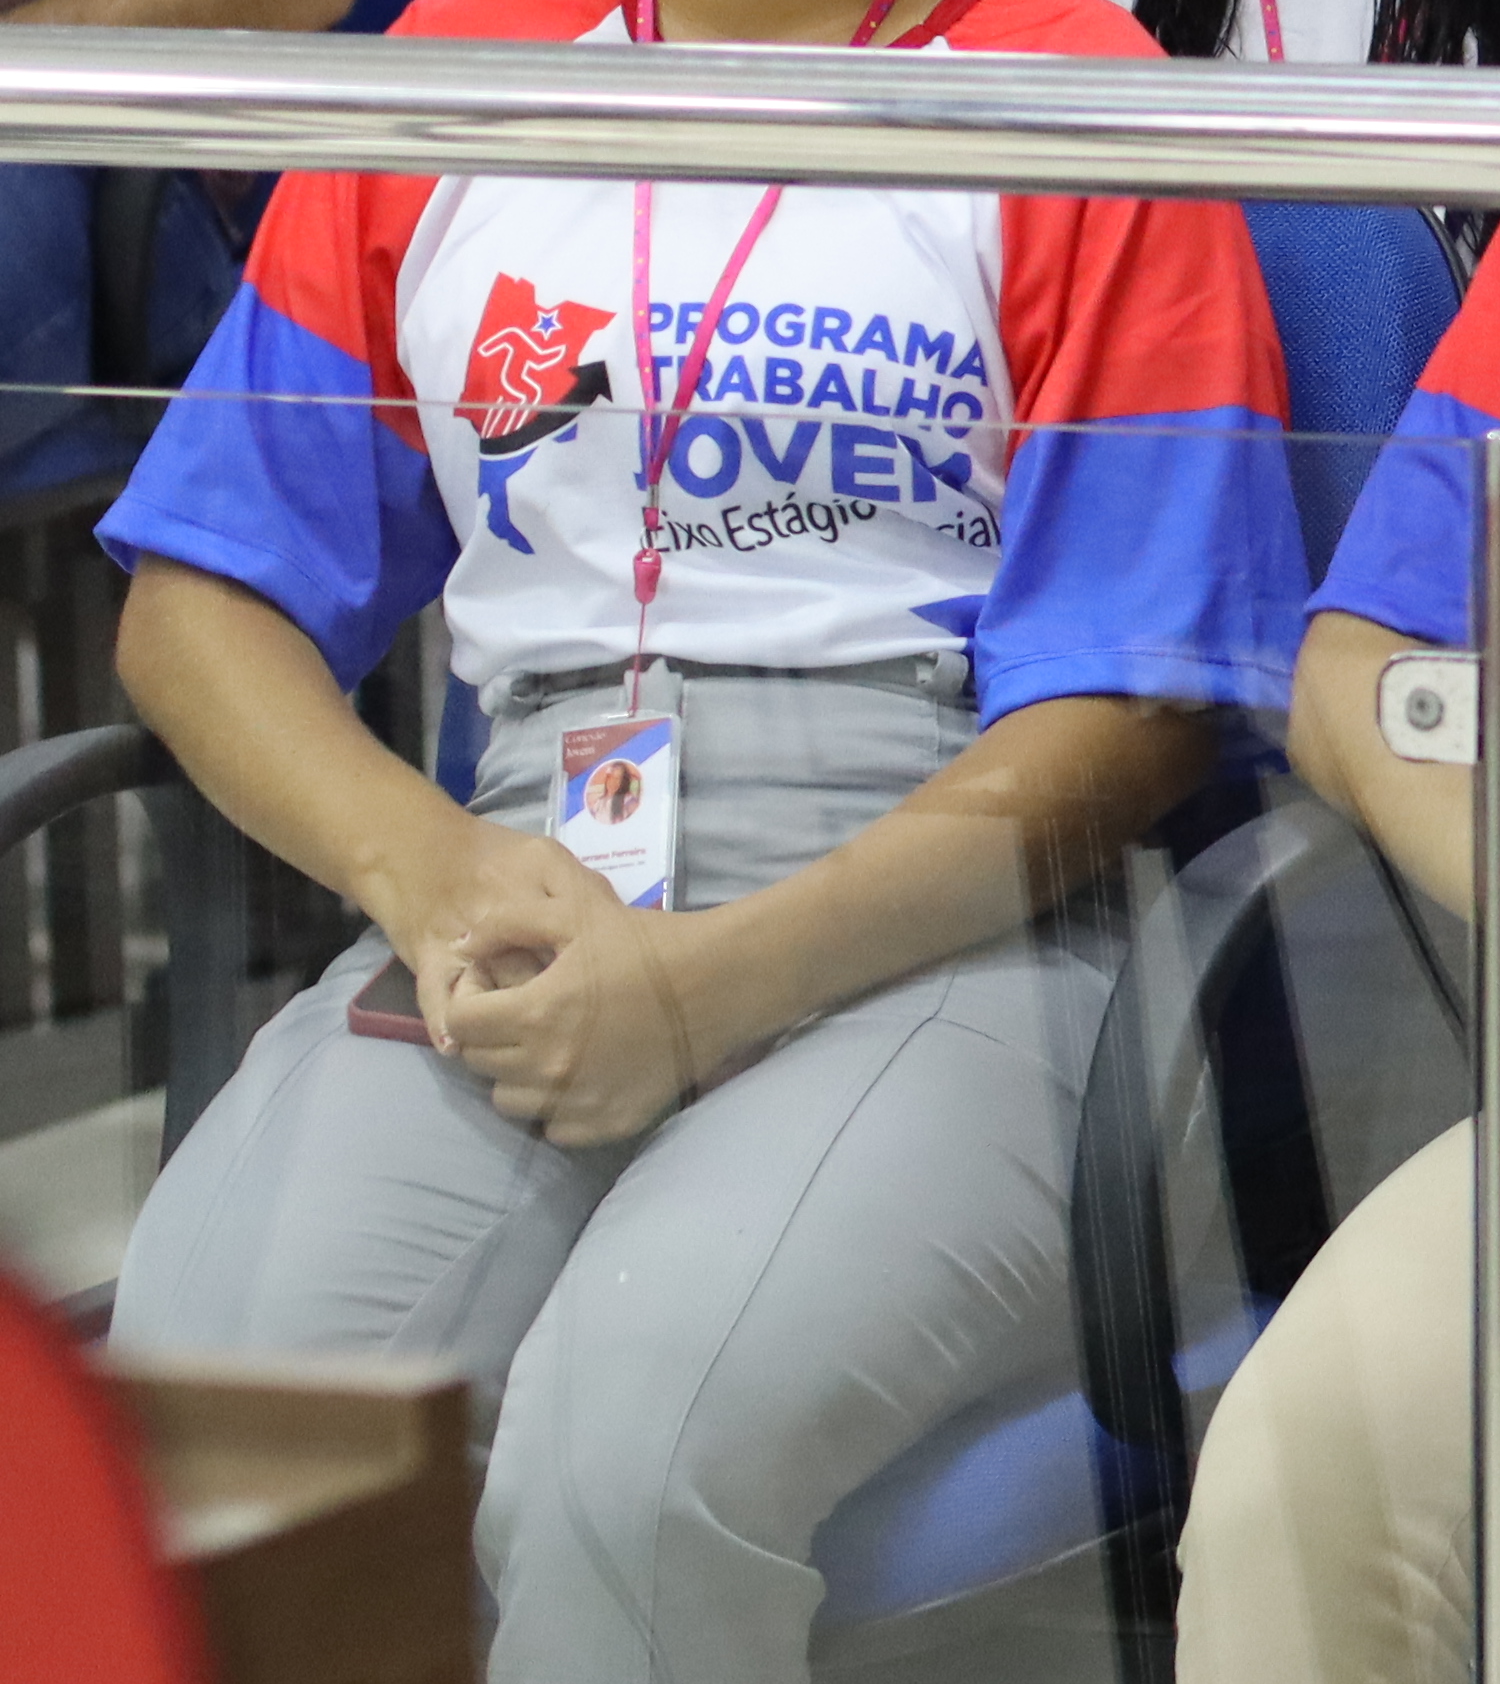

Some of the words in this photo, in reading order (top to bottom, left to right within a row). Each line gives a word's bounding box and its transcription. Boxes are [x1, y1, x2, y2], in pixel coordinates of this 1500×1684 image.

[649, 302, 988, 387] PROGRAMA
[651, 355, 983, 439] TRABALHO
[721, 491, 877, 552] Estágio
